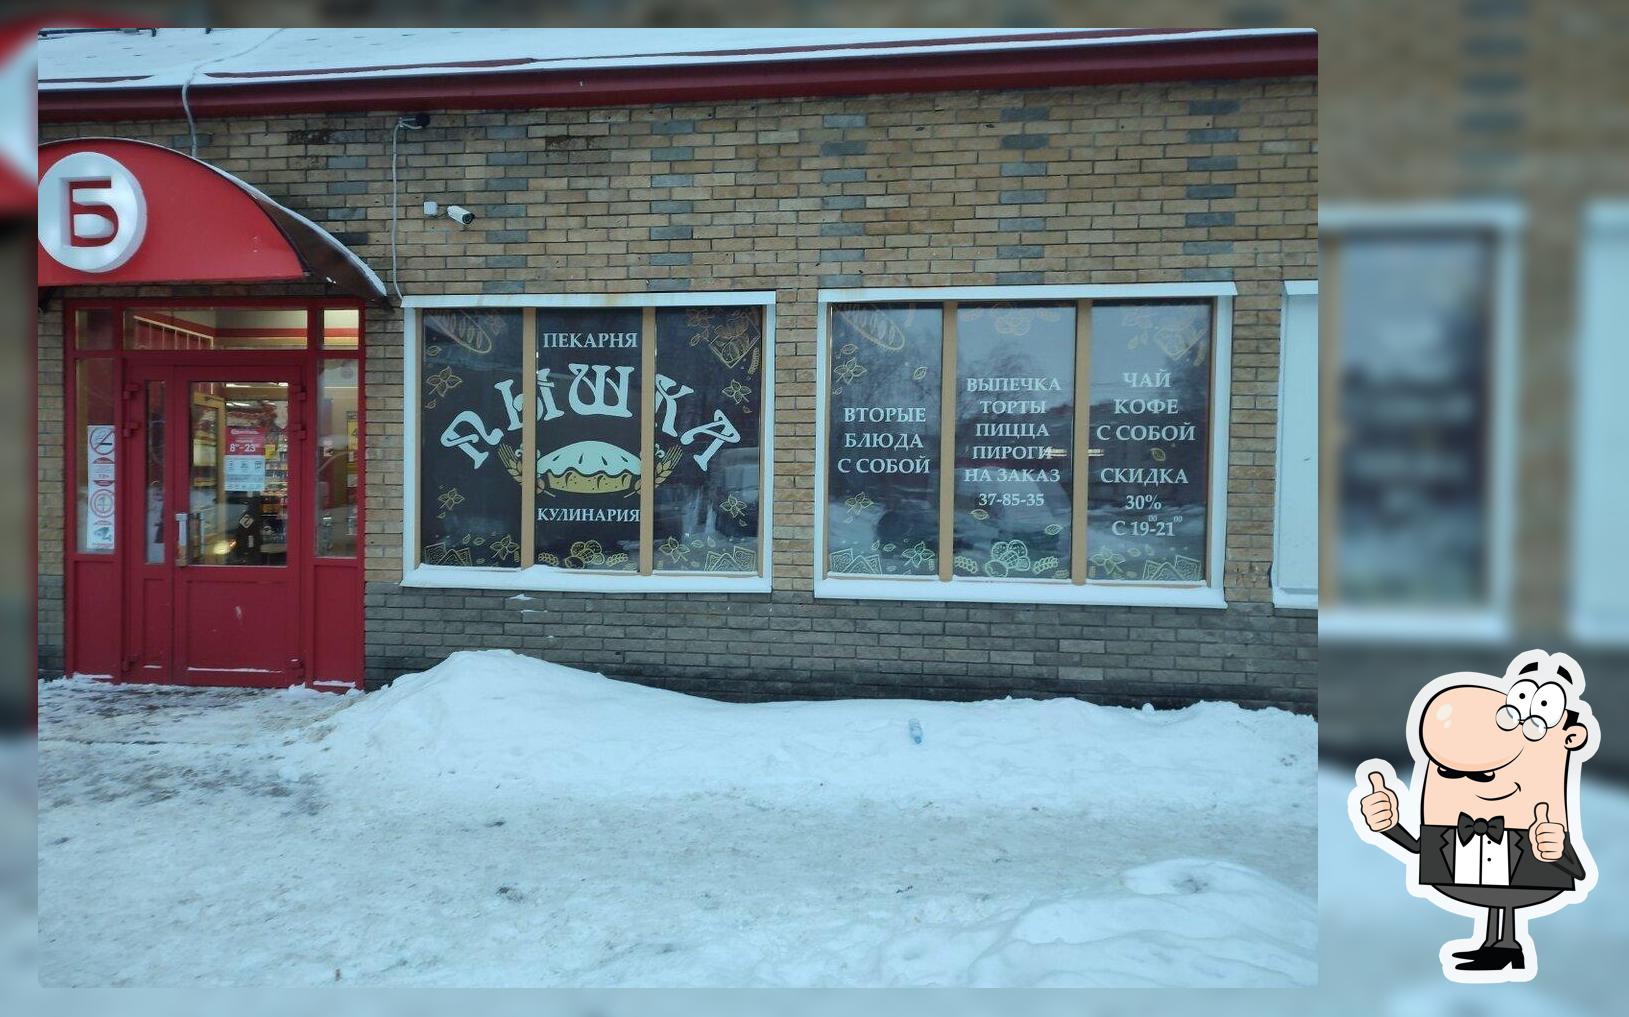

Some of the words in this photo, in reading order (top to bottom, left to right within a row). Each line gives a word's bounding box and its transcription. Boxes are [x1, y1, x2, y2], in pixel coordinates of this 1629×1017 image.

[59, 176, 119, 248] Б
[543, 332, 638, 348] ПЕКАРНЯ
[965, 377, 1062, 392] ВЫПЕЧКА
[1123, 368, 1172, 388] ЧАЙ
[979, 400, 1047, 414] ТОРТЫ
[1113, 399, 1179, 414] КОФЕ
[440, 363, 741, 471] ПЫШКА
[843, 407, 927, 423] ВТОРЫЕ
[975, 423, 1051, 439] ПИЦЦА
[1096, 424, 1111, 441] С
[1115, 421, 1197, 441] СОБОЙ
[843, 432, 924, 451] БЛЮДА
[972, 446, 1053, 460] ПИРОГИ
[837, 458, 852, 474] С
[855, 455, 931, 474] СОБОЙ
[963, 468, 993, 483] НА
[997, 468, 1062, 483] ЗАКАЗ
[1100, 467, 1190, 487] СКИДКА
[978, 493, 1045, 507] 37-85-35
[1124, 494, 1163, 510] 30%
[537, 507, 641, 522] КУЛИНАРИЯ
[1111, 520, 1126, 536] С
